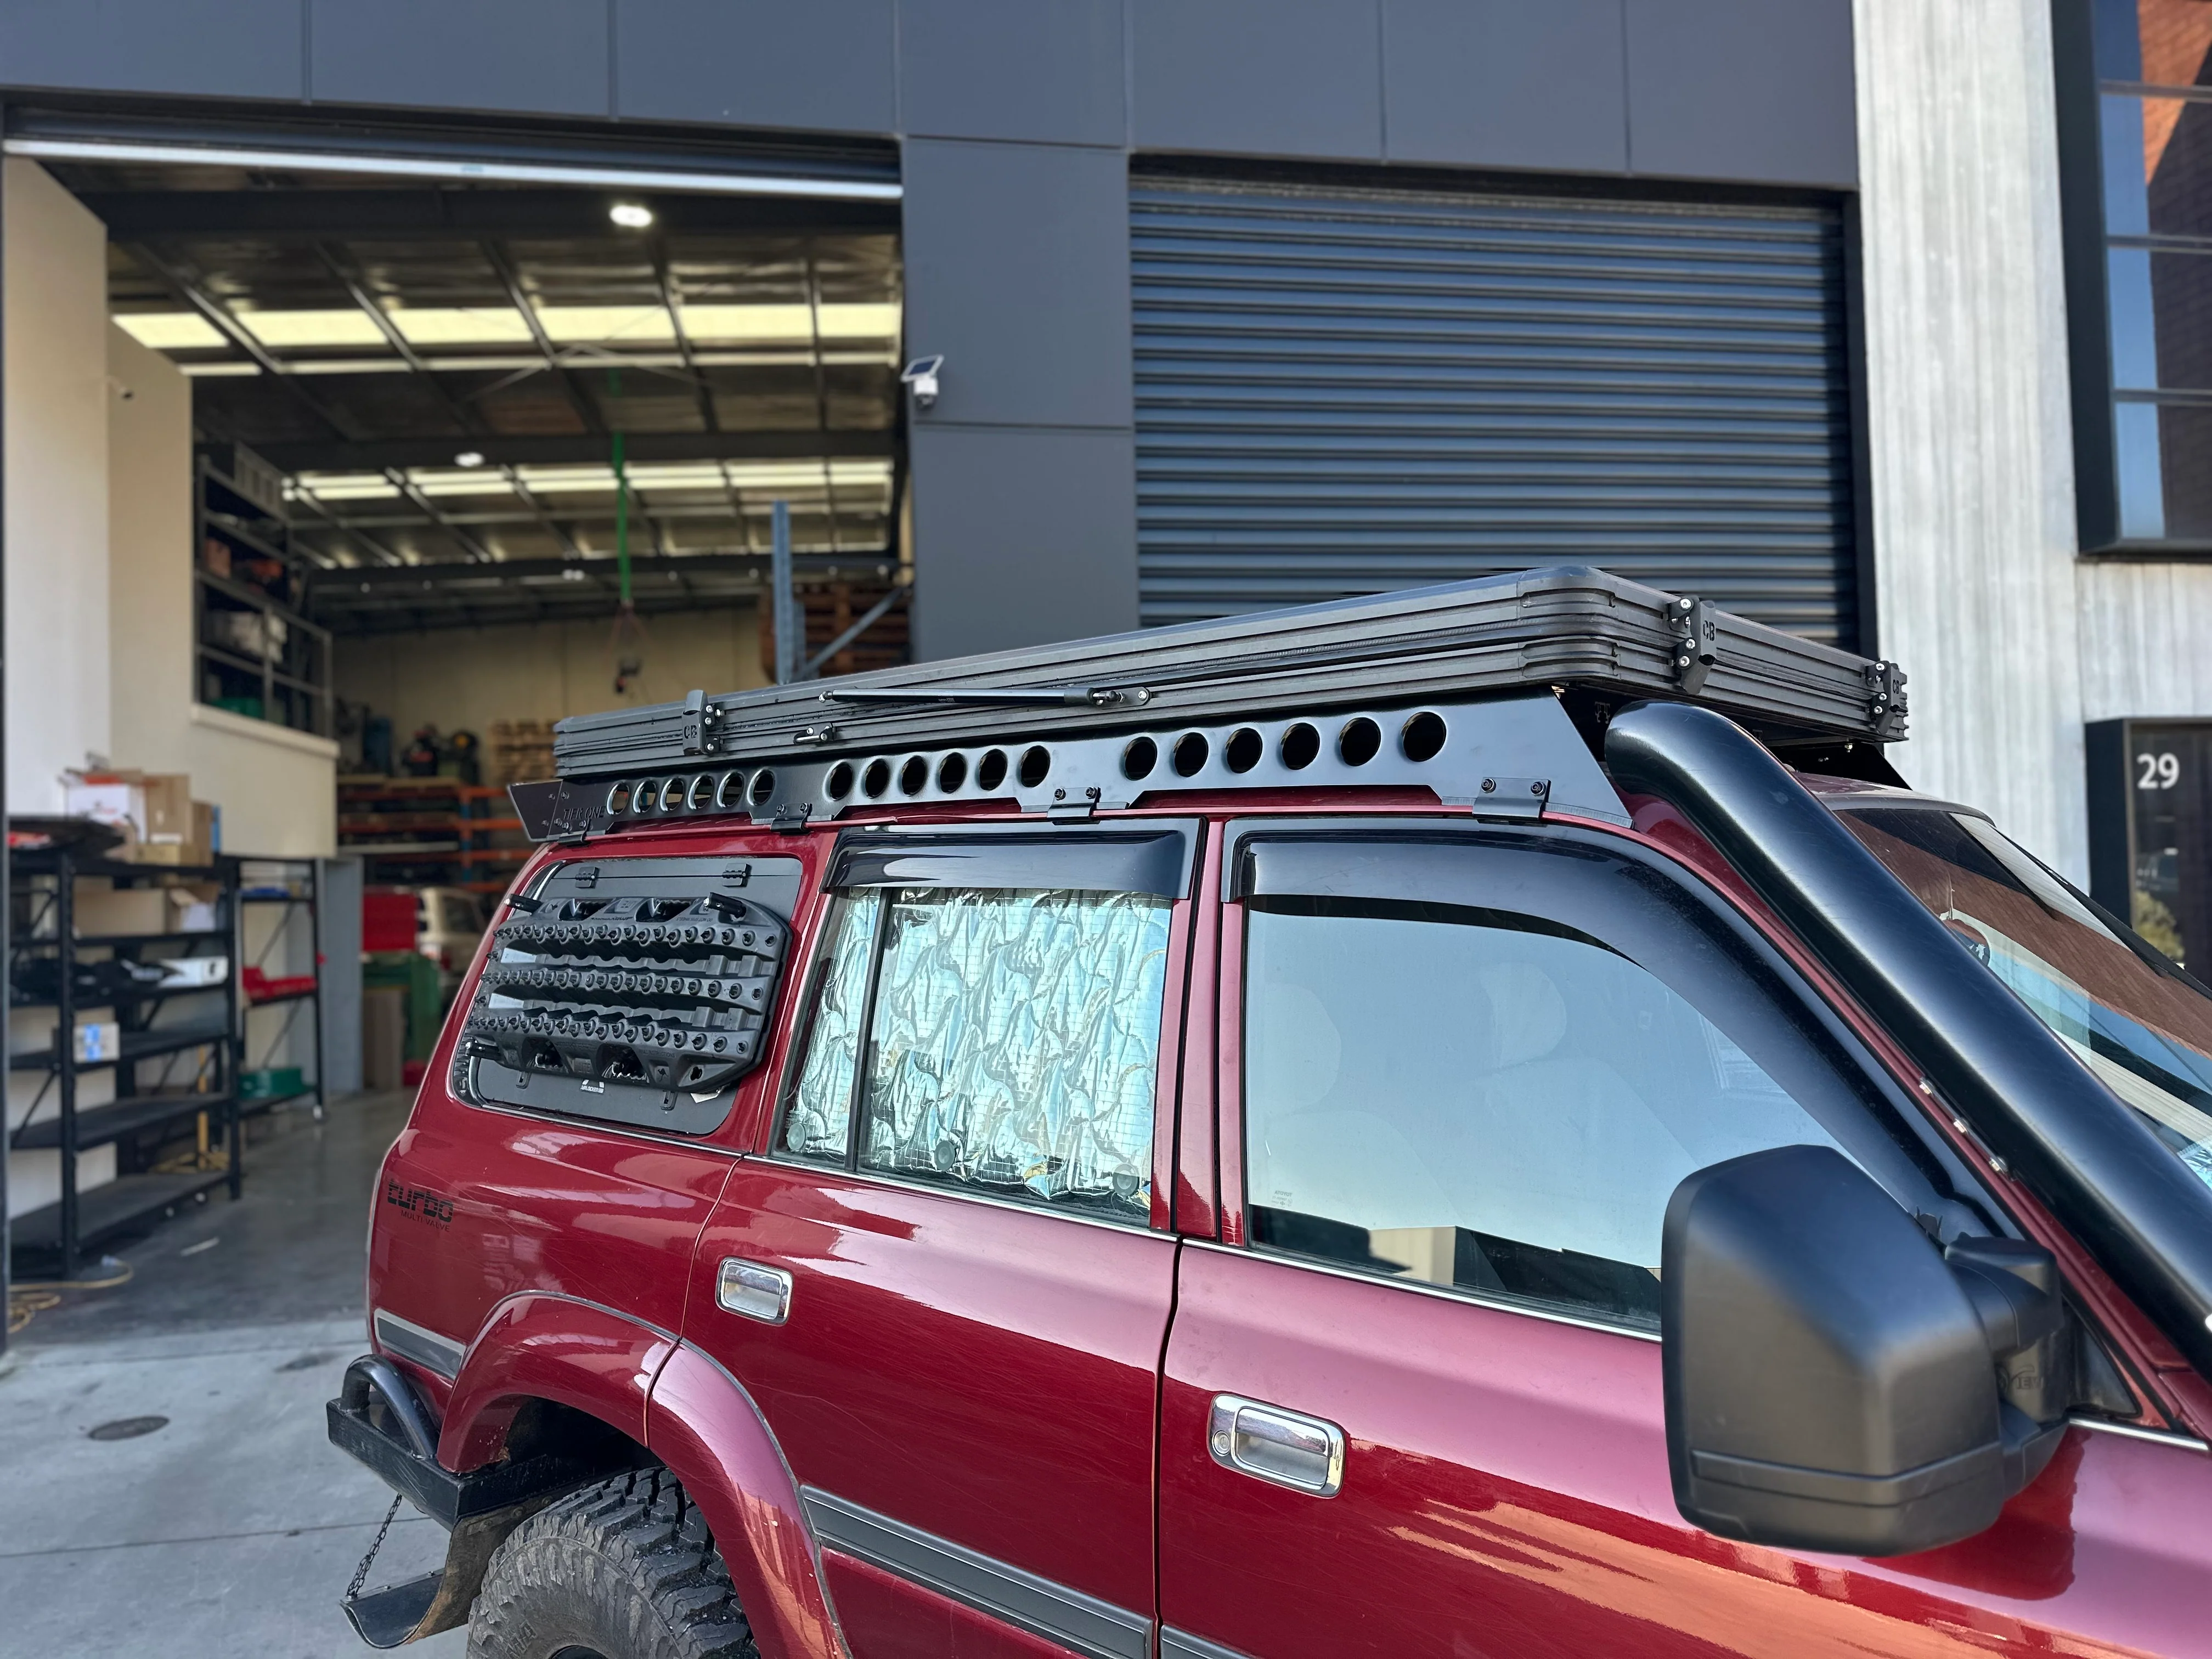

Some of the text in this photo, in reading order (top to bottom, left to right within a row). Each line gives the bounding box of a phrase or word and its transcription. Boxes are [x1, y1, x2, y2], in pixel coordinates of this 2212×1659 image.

[1703, 620, 1715, 641] CB
[684, 725, 697, 739] CB
[2137, 753, 2180, 789] 29
[563, 805, 606, 820] TIER ONE
[387, 1178, 454, 1223] turbo
